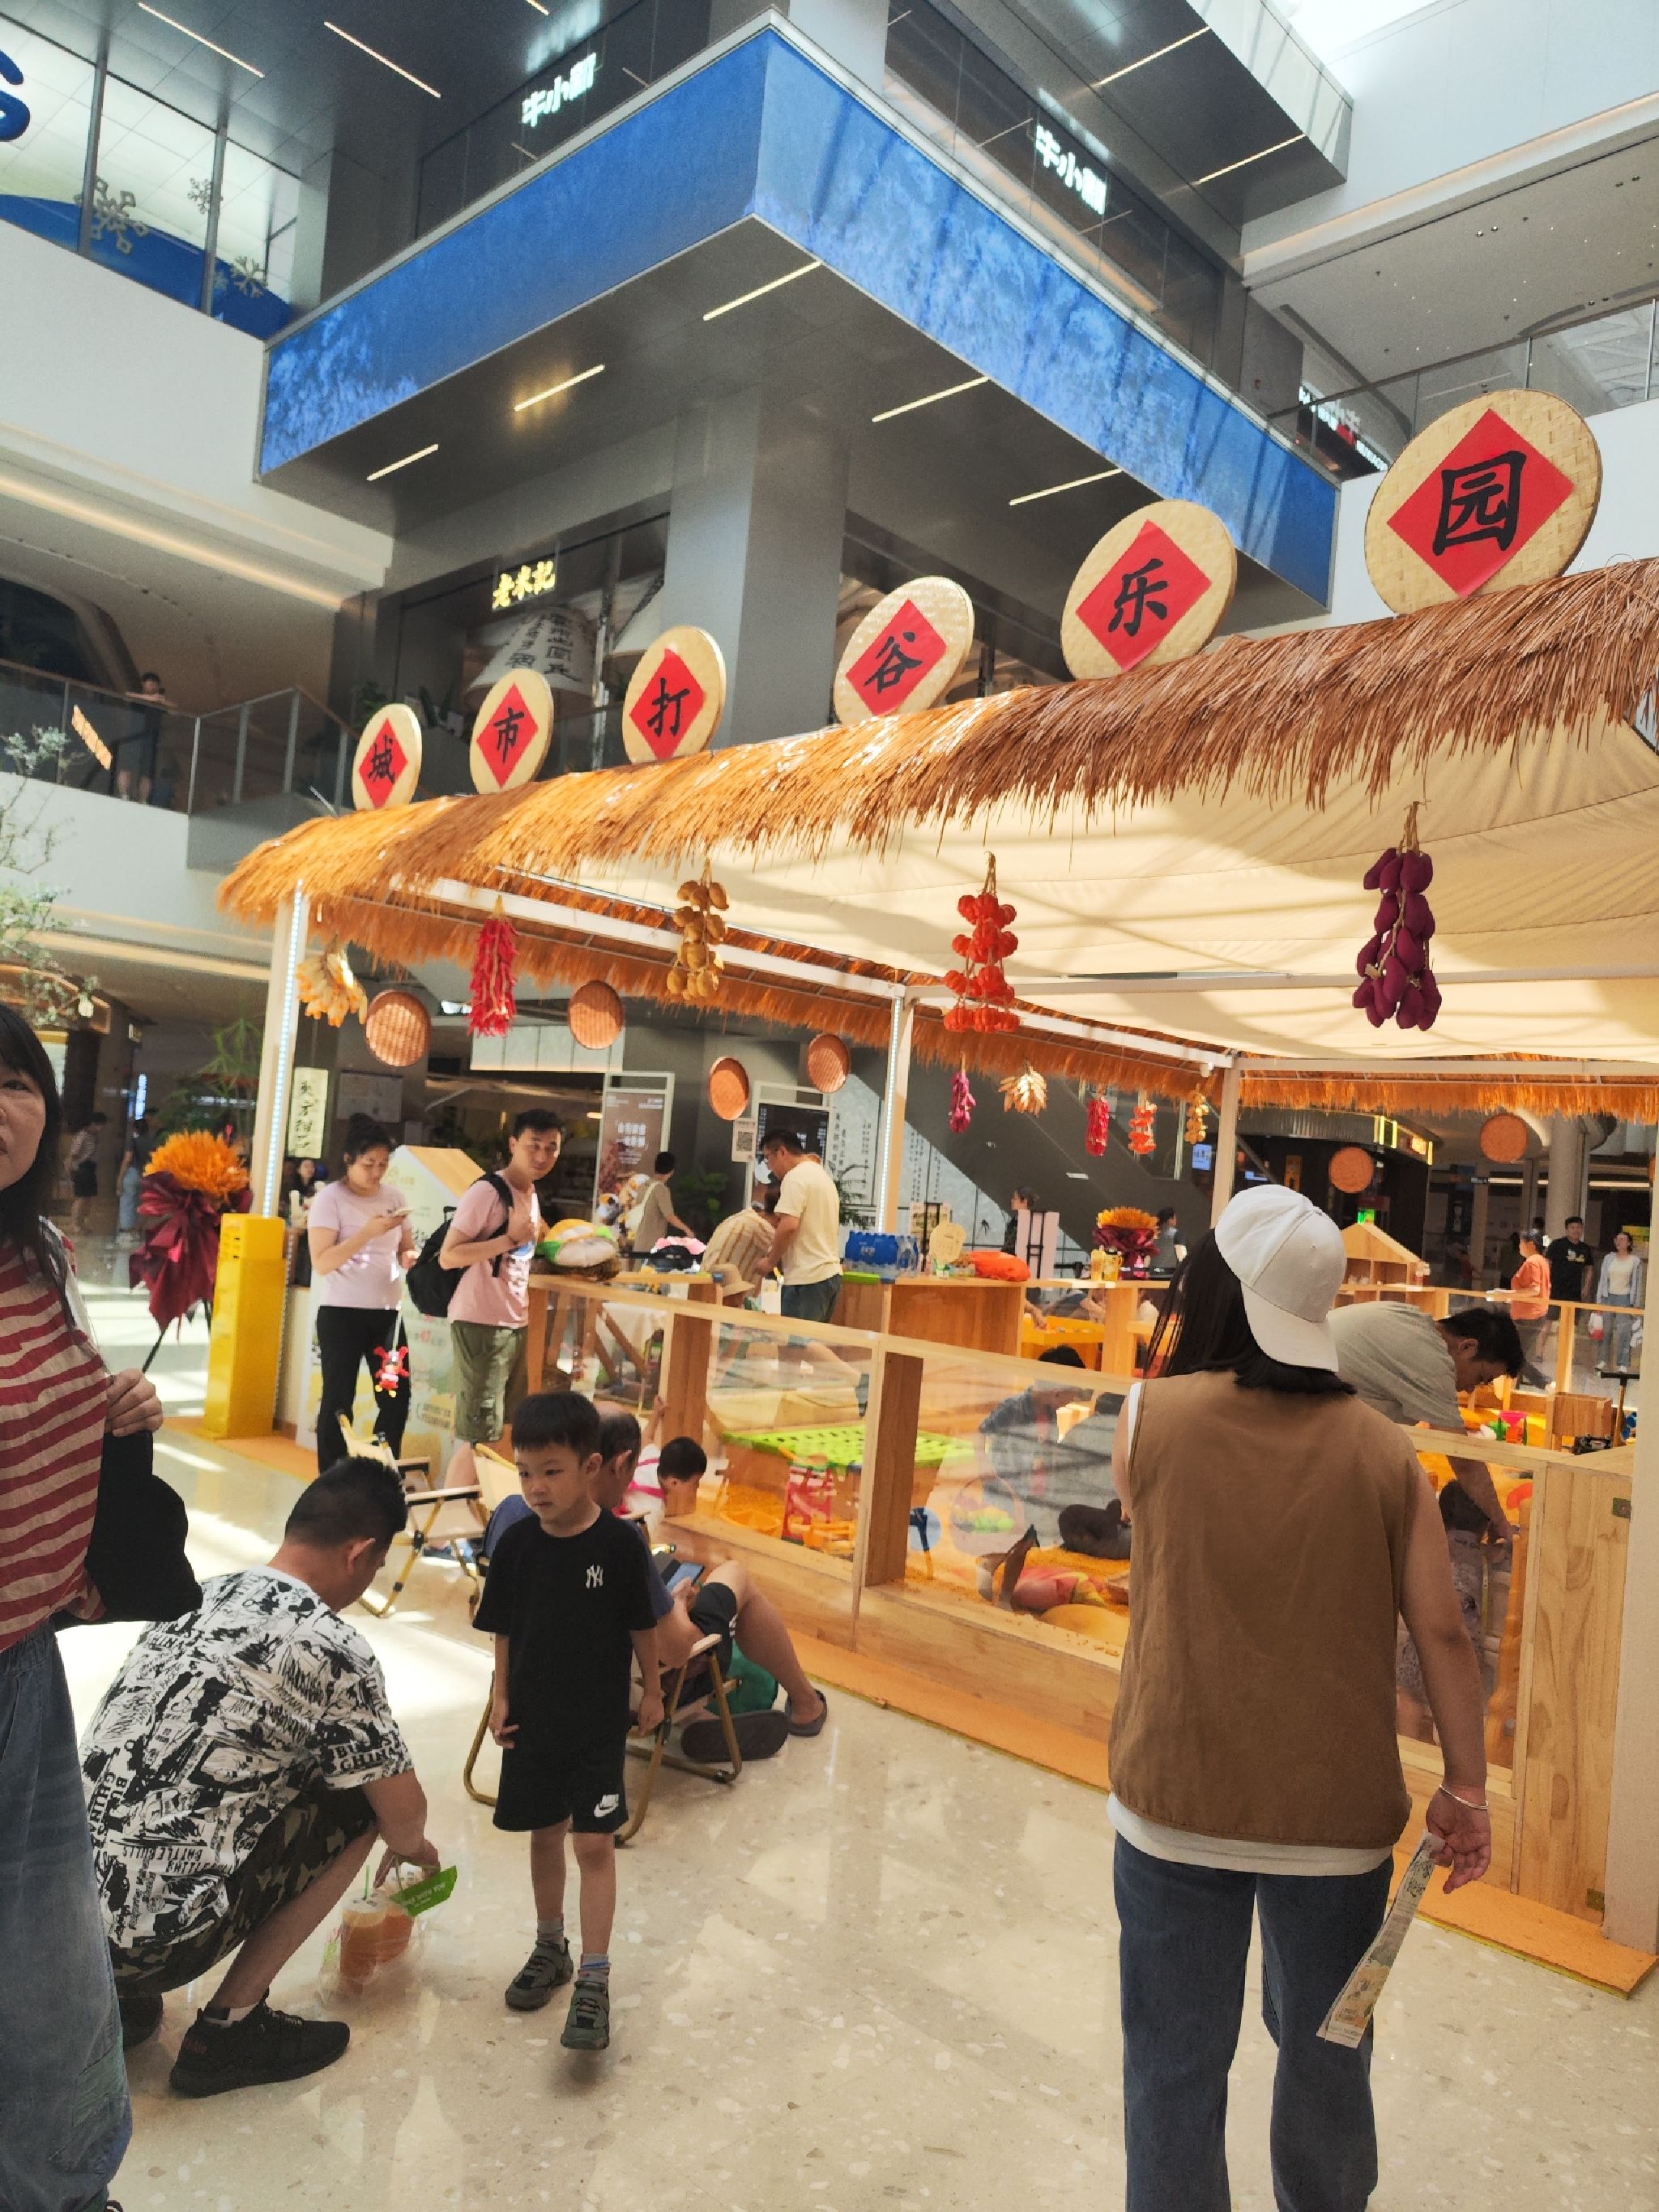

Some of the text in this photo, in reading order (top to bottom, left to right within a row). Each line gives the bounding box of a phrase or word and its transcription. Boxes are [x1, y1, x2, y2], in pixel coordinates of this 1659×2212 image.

[368, 450, 1528, 786] 城 市 打 谷 乐 园
[586, 1564, 603, 1589] NY
